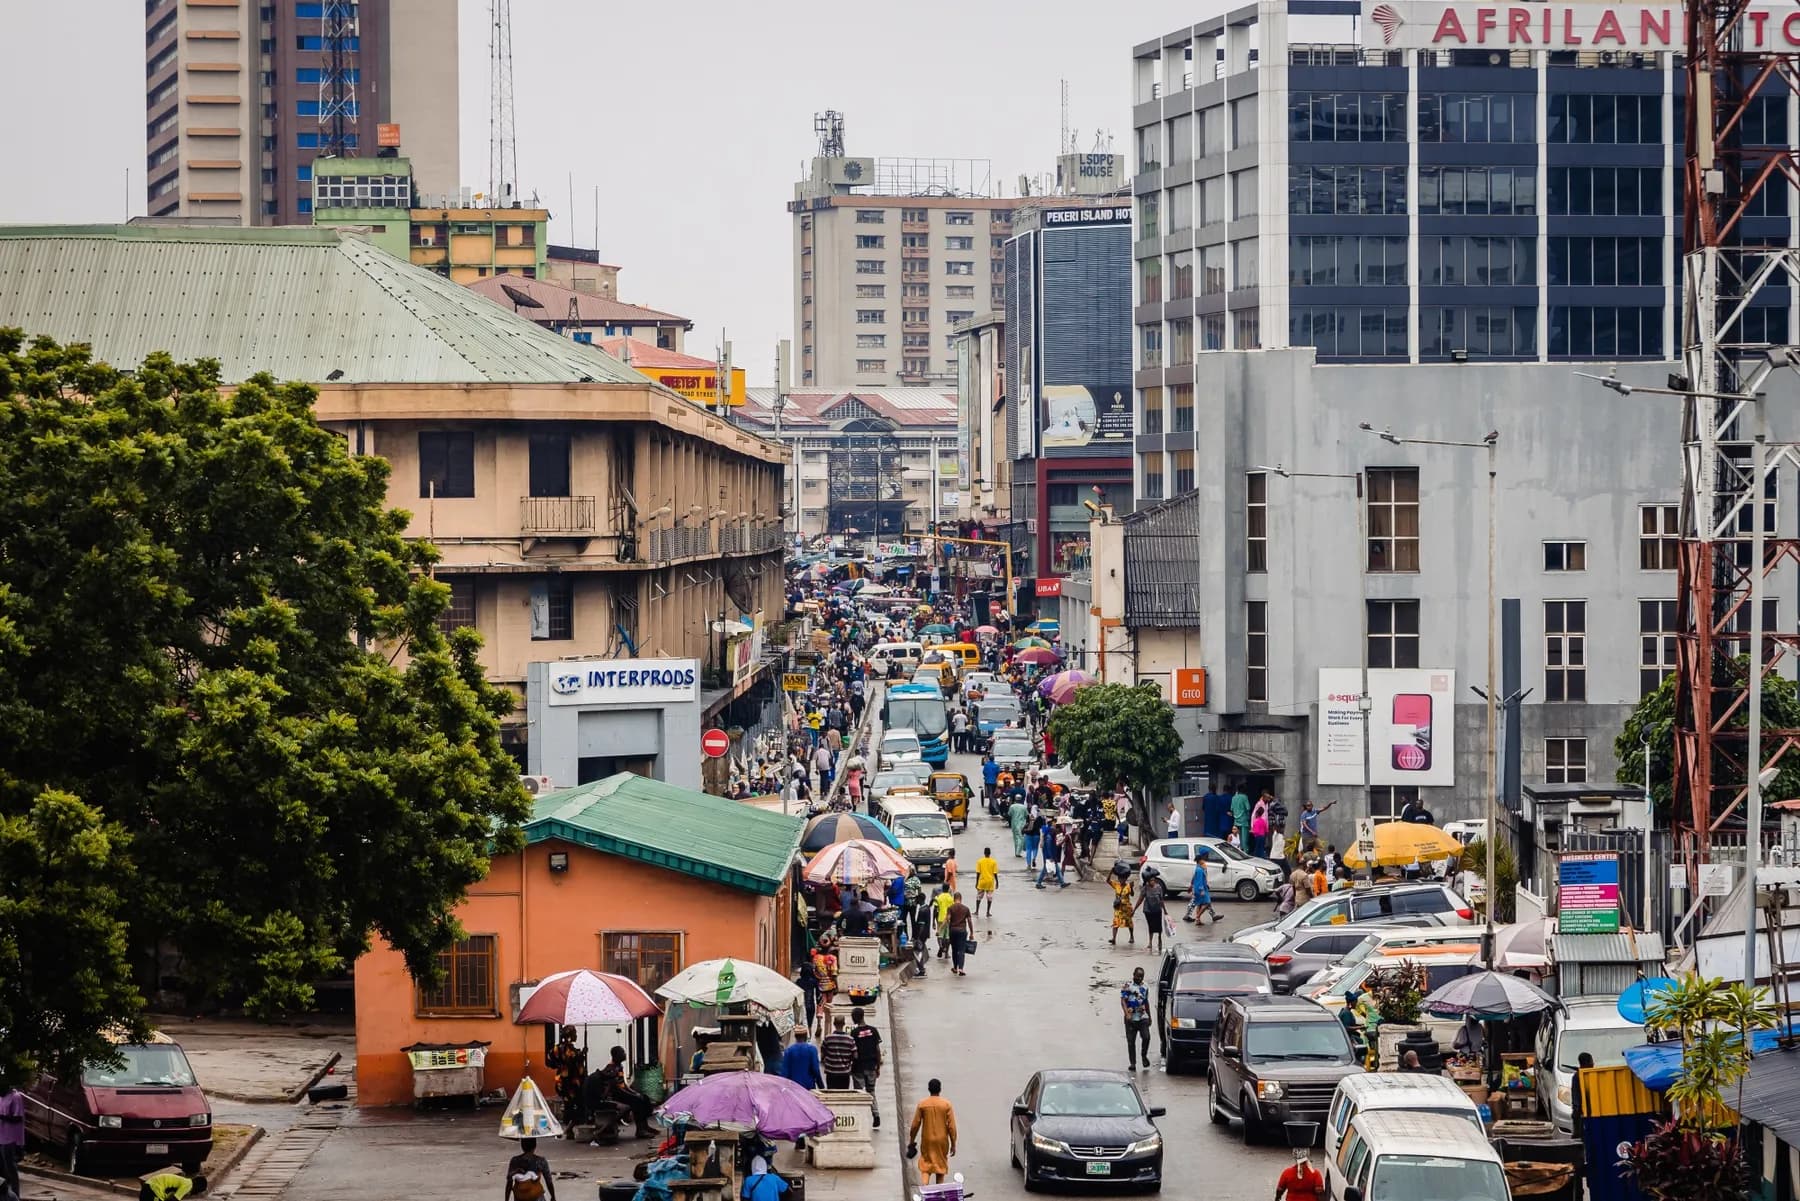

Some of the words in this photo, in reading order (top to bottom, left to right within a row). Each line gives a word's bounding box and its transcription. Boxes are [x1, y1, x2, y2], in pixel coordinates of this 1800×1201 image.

[1080, 154, 1113, 165] LSDPC
[1080, 166, 1113, 177] HOUSE
[1046, 210, 1079, 223] PEKERI
[1081, 209, 1113, 221] ISLAND
[1037, 585, 1053, 593] UBA
[588, 669, 694, 687] INTERPRODS
[1182, 689, 1201, 699] GTCO
[1335, 693, 1361, 704] squa
[850, 955, 865, 964] CBD
[835, 1115, 855, 1127] CBD
